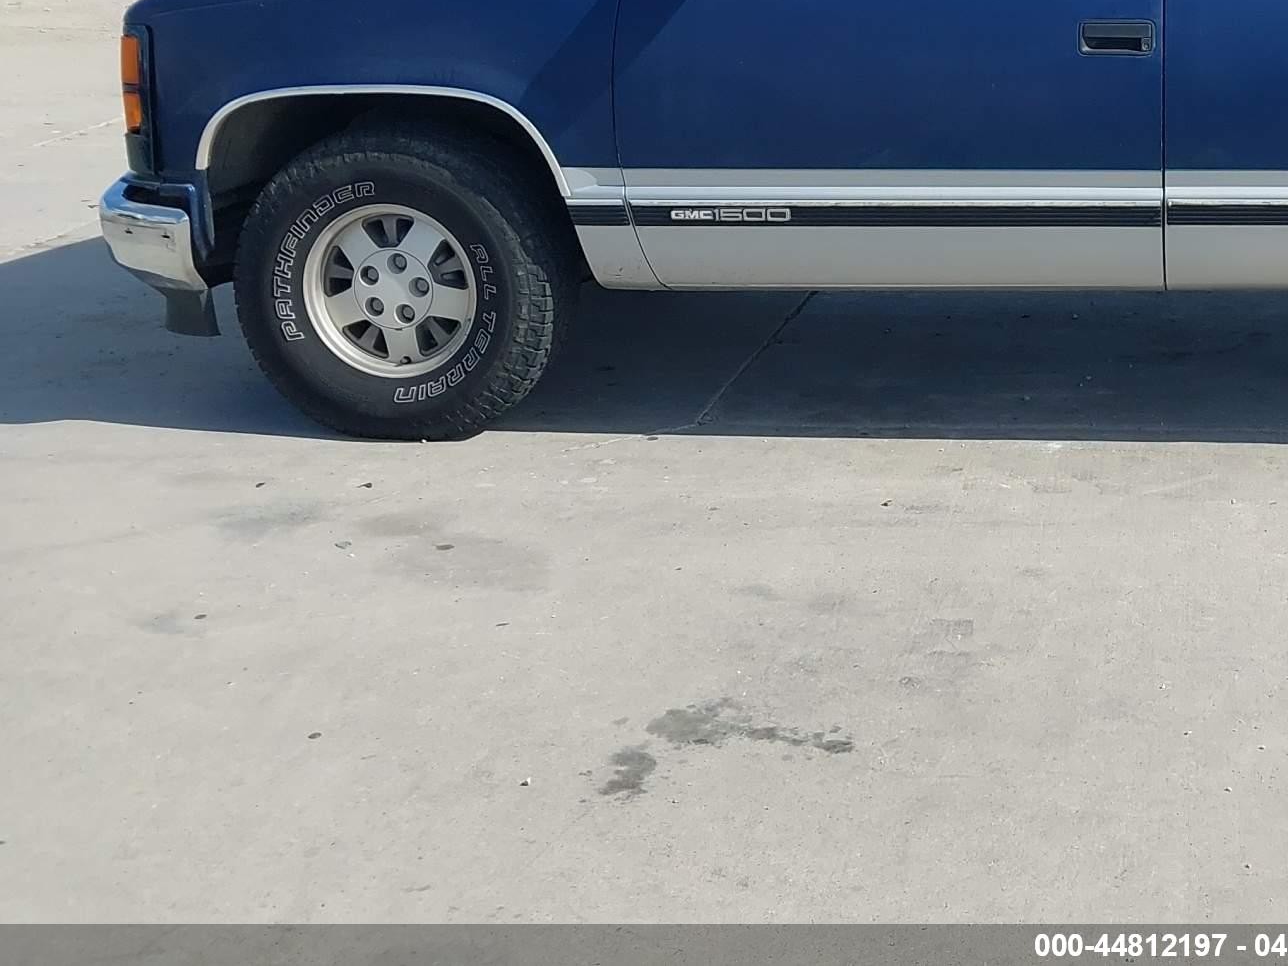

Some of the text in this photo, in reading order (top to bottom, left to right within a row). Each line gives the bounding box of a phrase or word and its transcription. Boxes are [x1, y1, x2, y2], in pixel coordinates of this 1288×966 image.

[273, 180, 376, 343] PATHFINDER
[670, 208, 791, 222] GMC 1500
[393, 243, 497, 404] ALL TERRAIN
